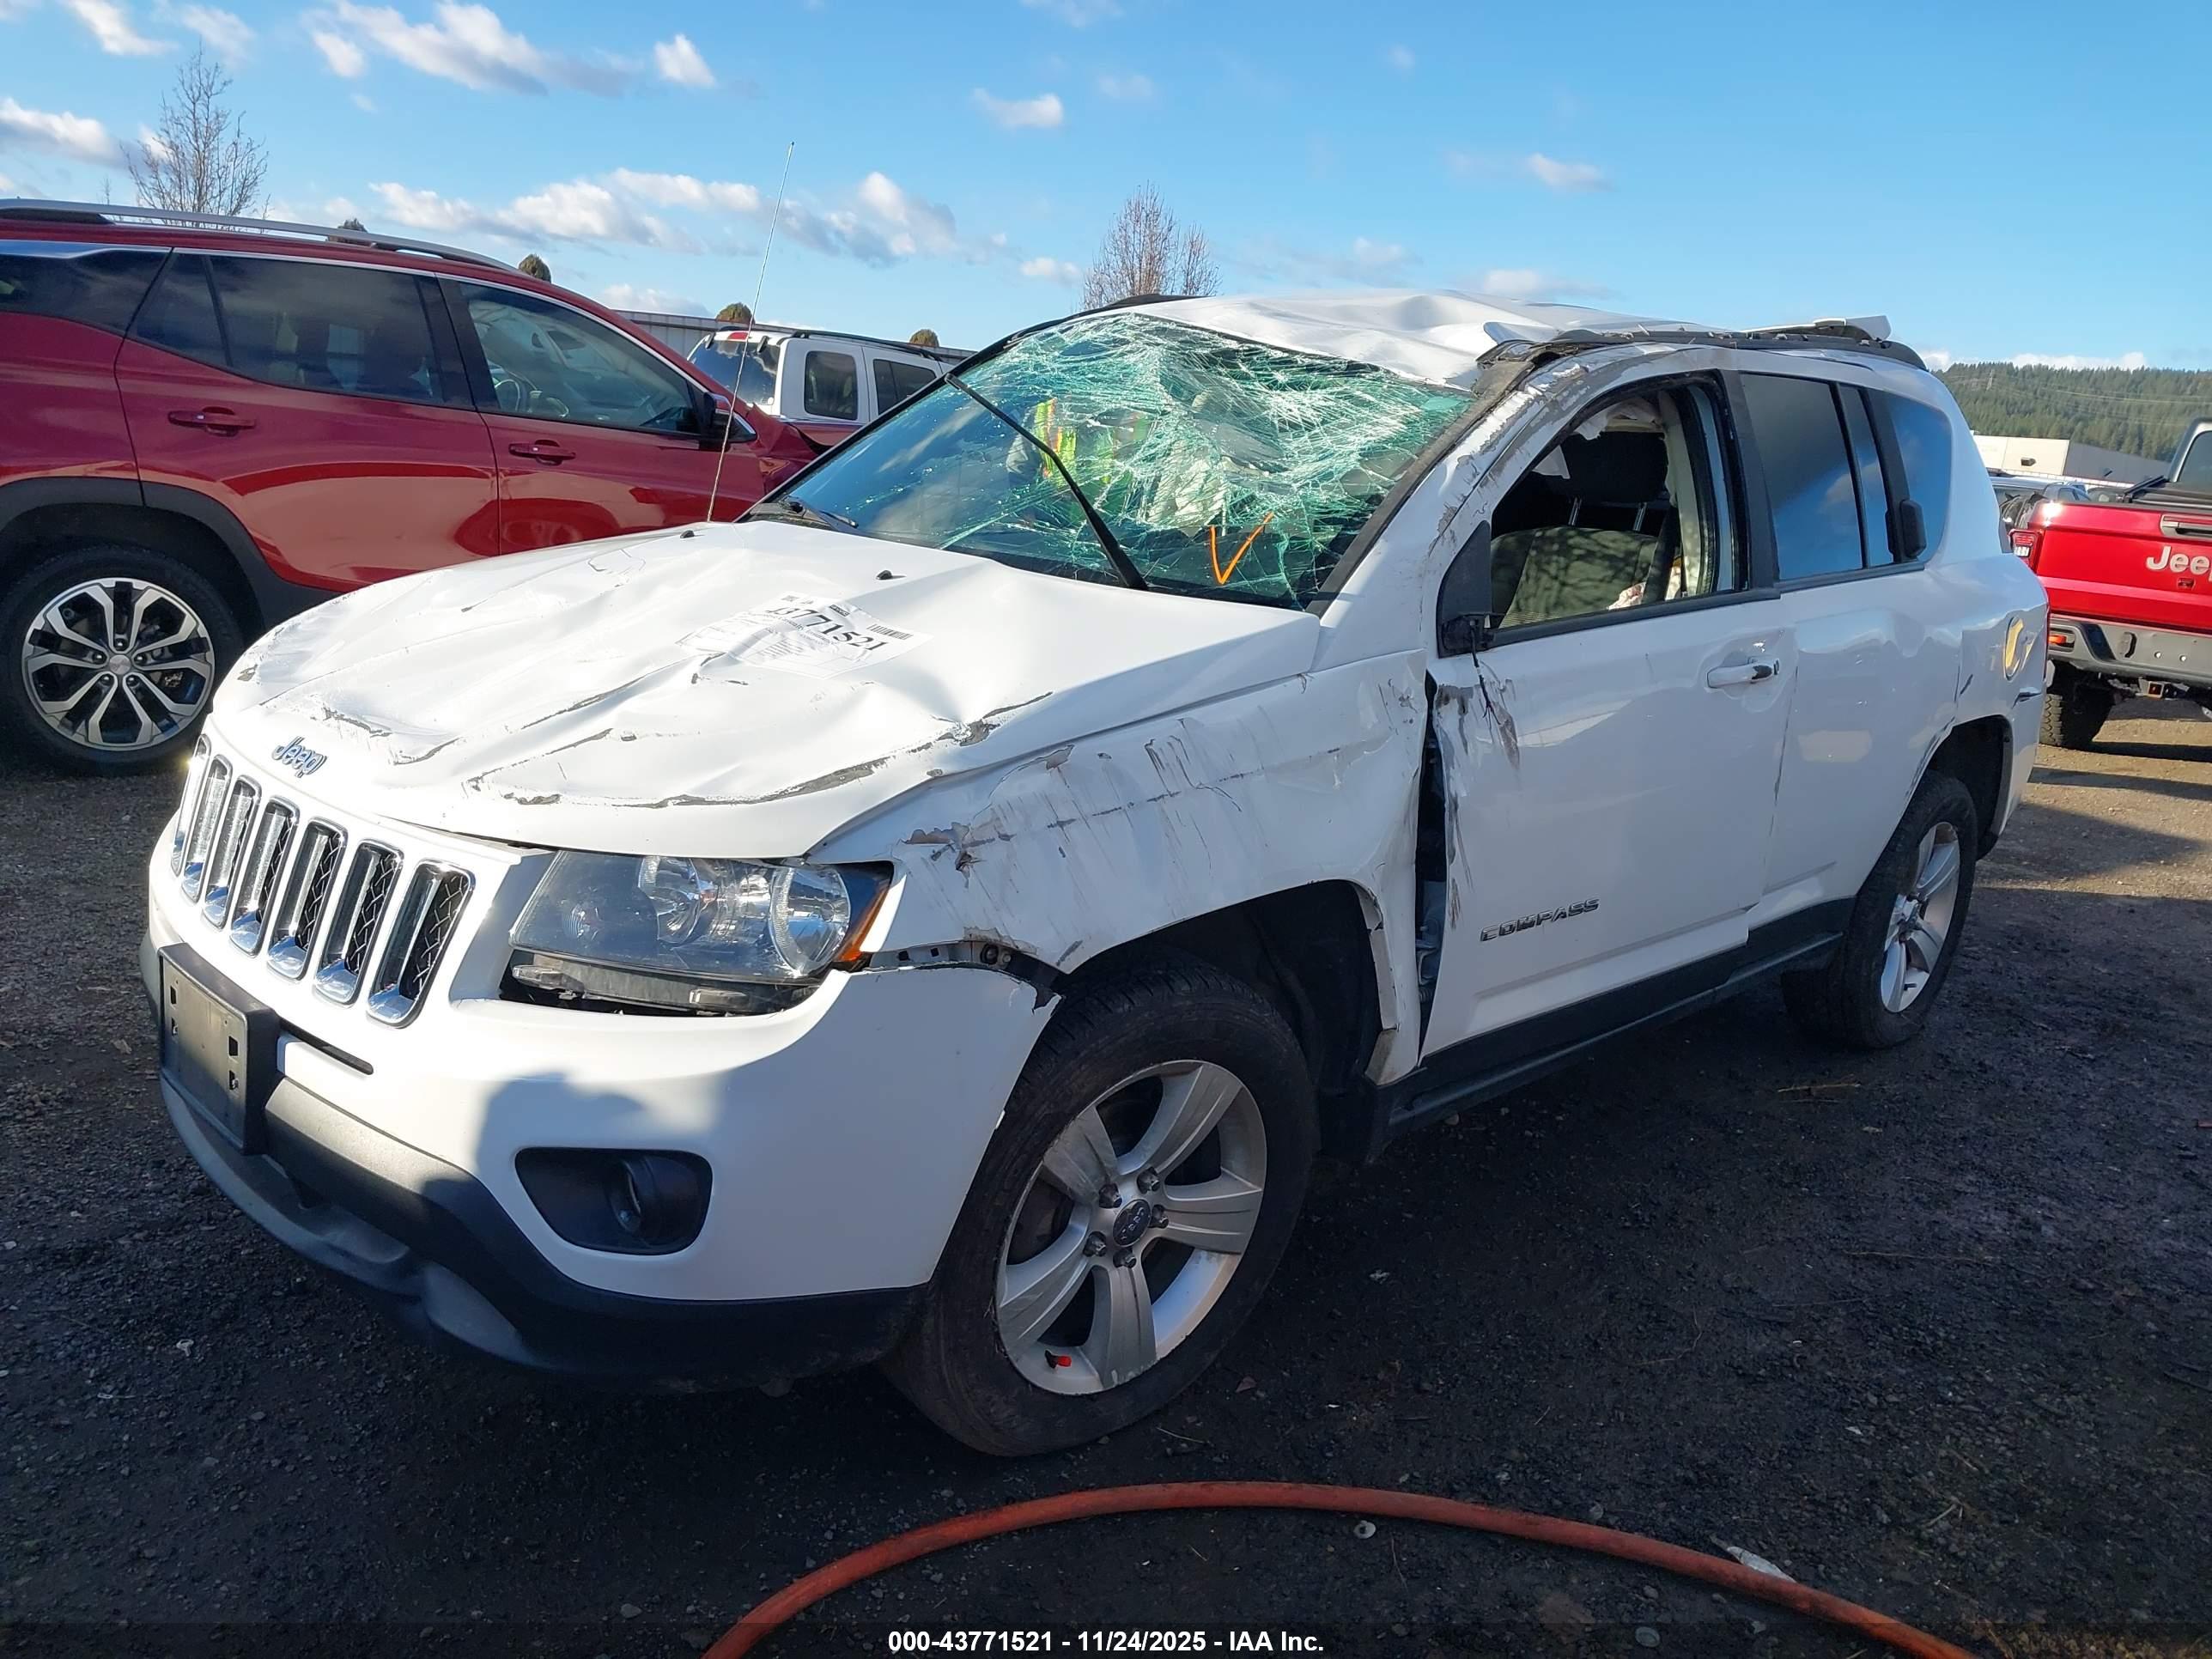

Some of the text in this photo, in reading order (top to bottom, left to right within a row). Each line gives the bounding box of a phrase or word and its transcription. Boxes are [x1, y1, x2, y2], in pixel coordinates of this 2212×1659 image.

[2146, 545, 2212, 583] Jee
[271, 736, 327, 778] Jeep
[1480, 897, 1600, 942] COMPASS
